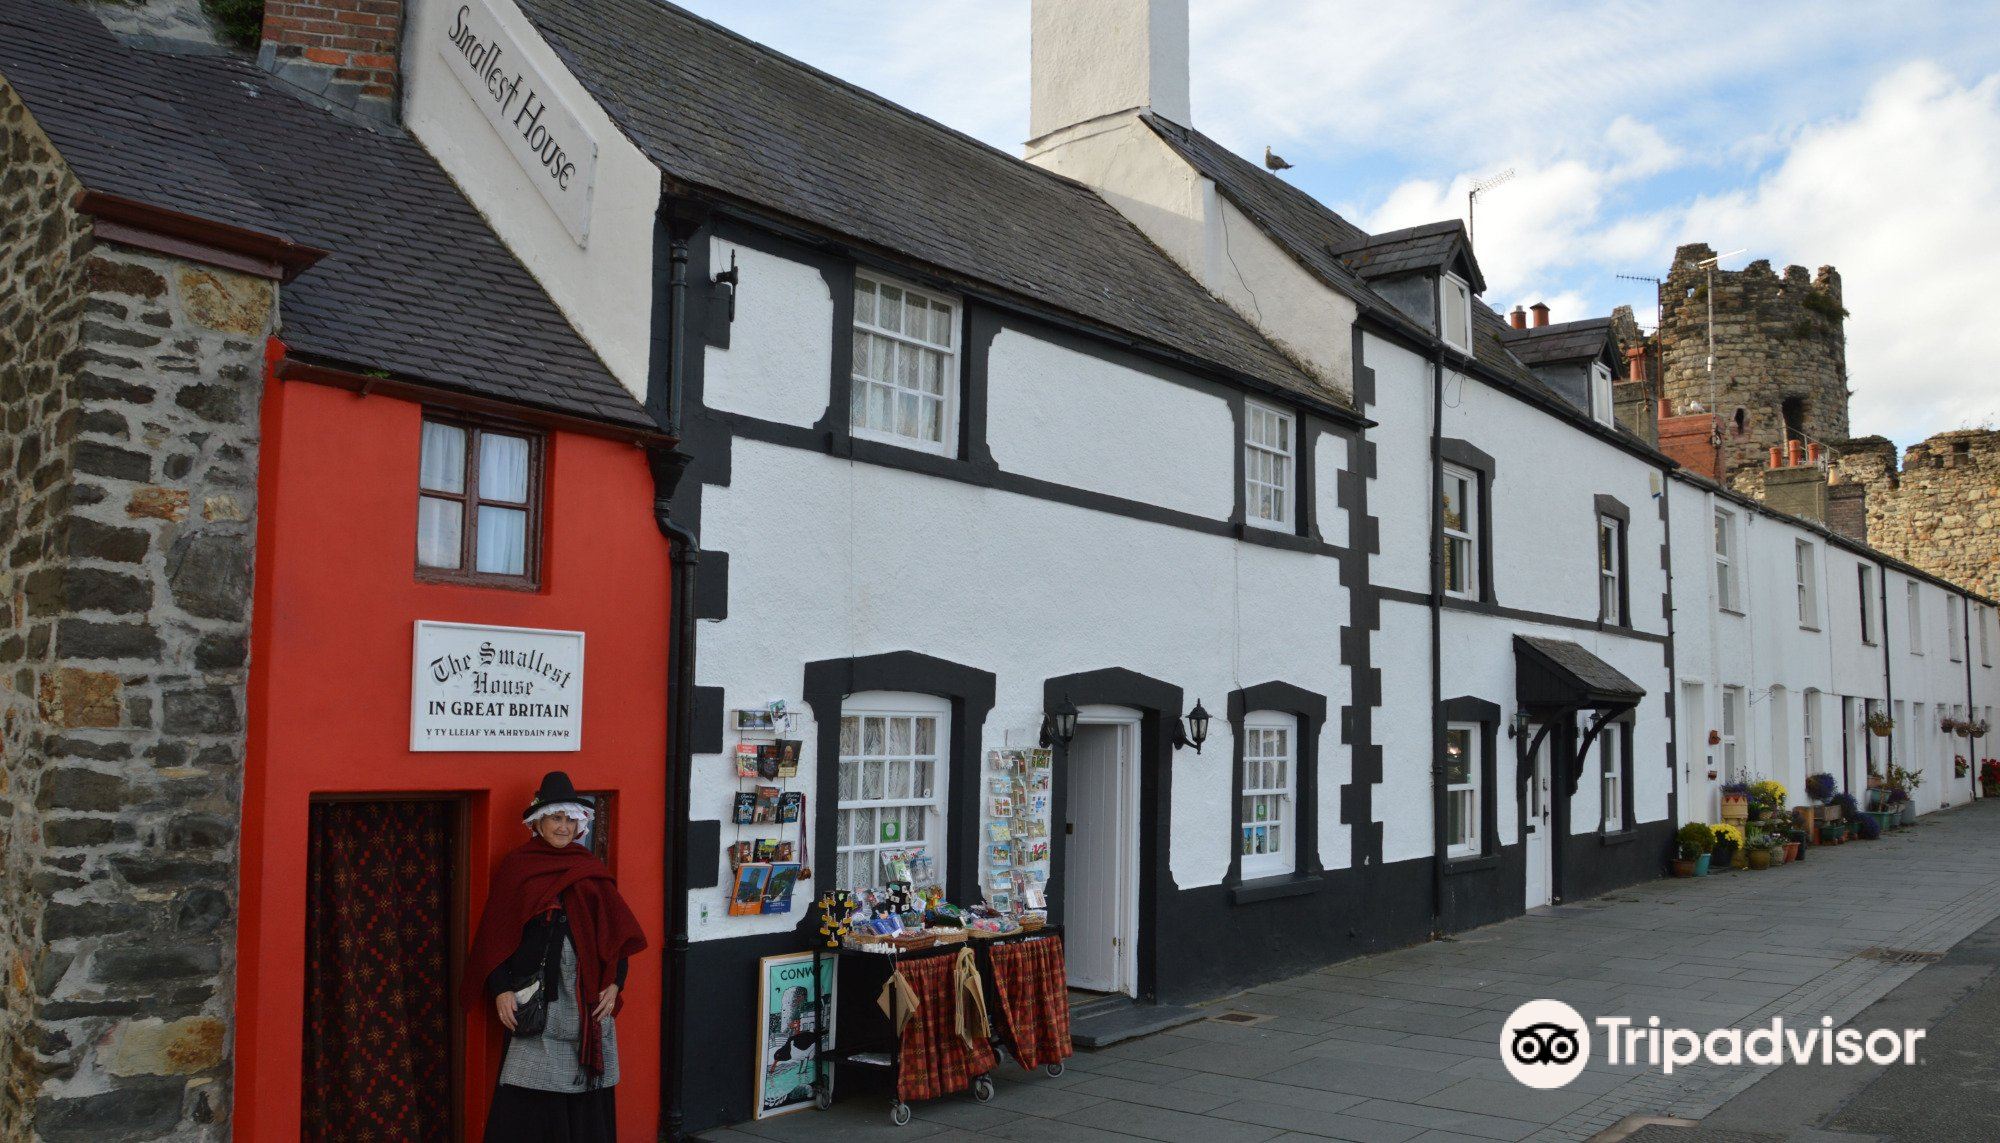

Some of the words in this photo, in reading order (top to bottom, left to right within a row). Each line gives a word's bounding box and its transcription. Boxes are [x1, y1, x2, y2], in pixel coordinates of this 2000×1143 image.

[448, 4, 524, 117] Smallest
[513, 88, 576, 192] House
[430, 654, 472, 683] The
[479, 641, 571, 689] Smallest
[472, 671, 534, 696] House
[428, 701, 446, 716] IN
[450, 701, 505, 717] GREAT
[509, 703, 570, 718] BRITAIN
[435, 728, 447, 736] TY
[449, 728, 482, 737] LLEIAF
[483, 728, 496, 737] YM
[499, 729, 545, 738] MHRYDAIN
[547, 729, 570, 738] FAWR
